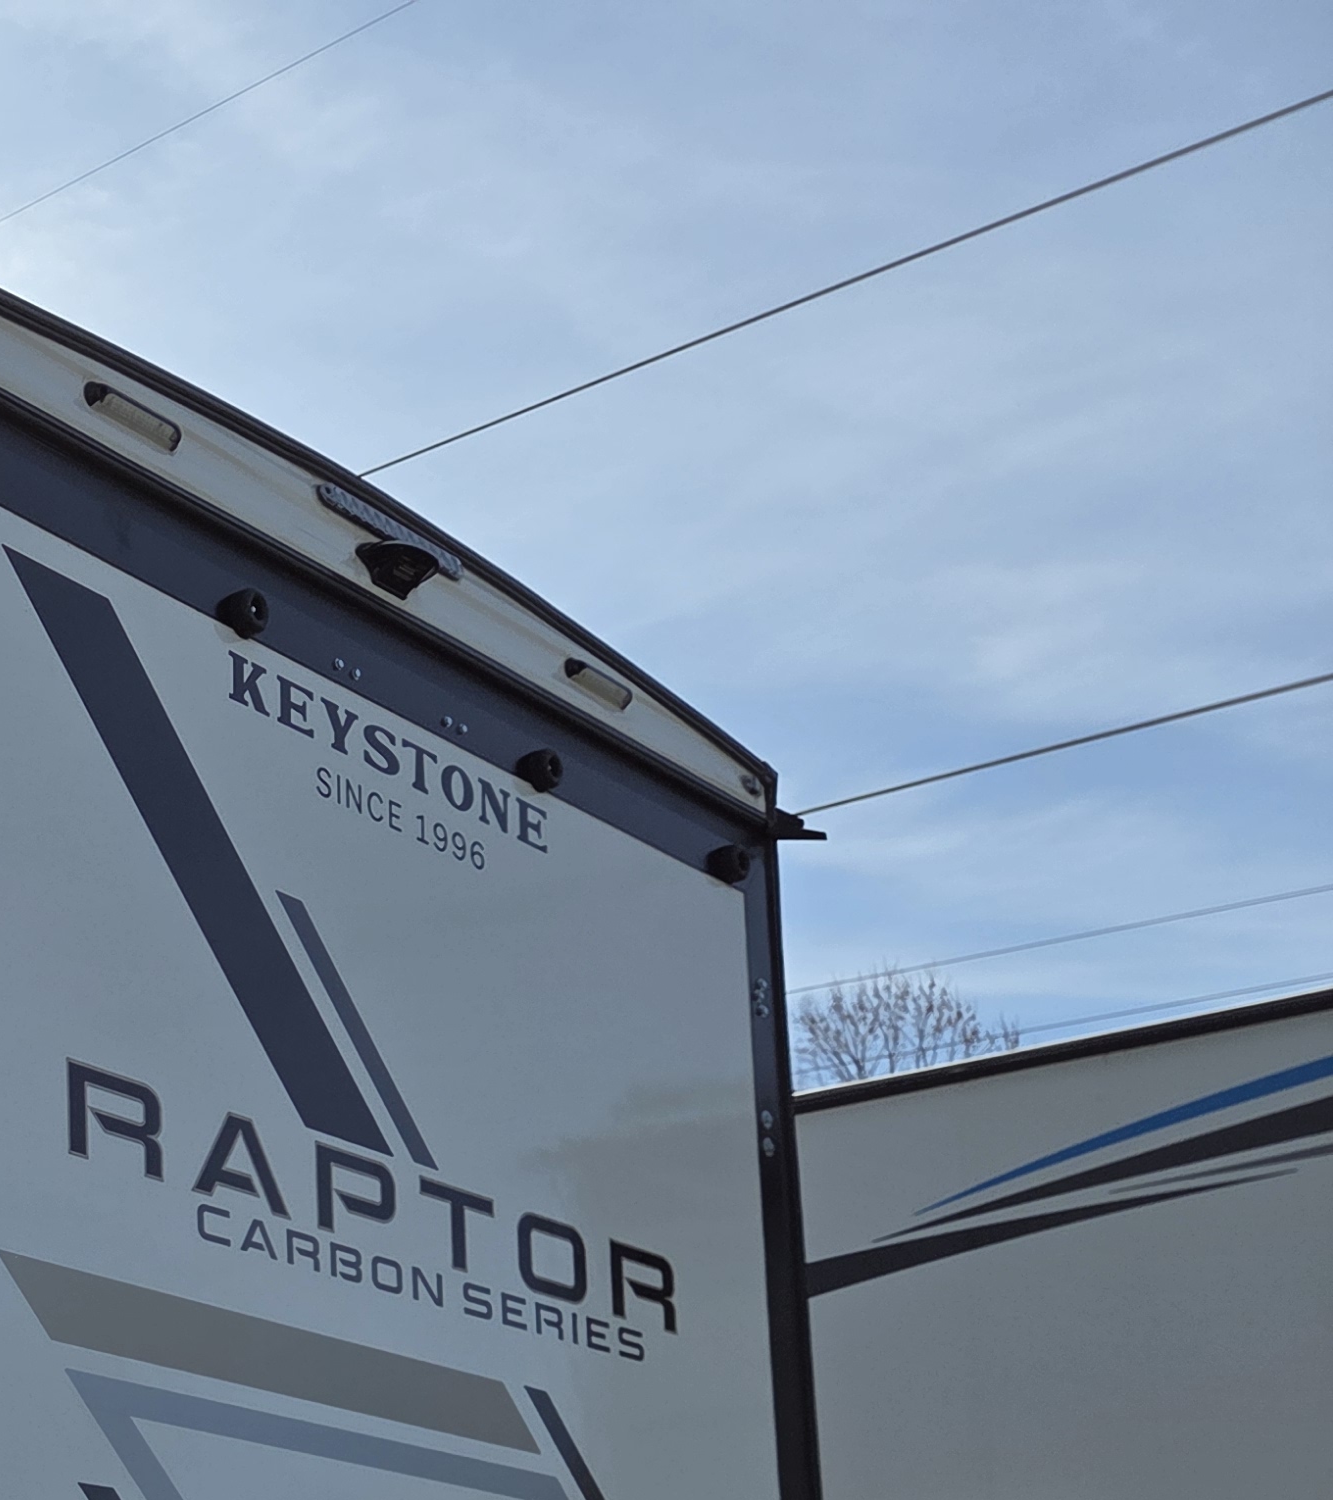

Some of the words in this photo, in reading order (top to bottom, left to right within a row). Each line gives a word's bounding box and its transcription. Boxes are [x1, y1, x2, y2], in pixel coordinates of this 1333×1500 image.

[227, 649, 549, 854] KEYSTONE
[315, 766, 403, 833] SINCE
[415, 814, 485, 871] 1996
[65, 1056, 679, 1335] RAPTOR
[196, 1203, 445, 1308] CARBON
[462, 1282, 646, 1362] SERIES
